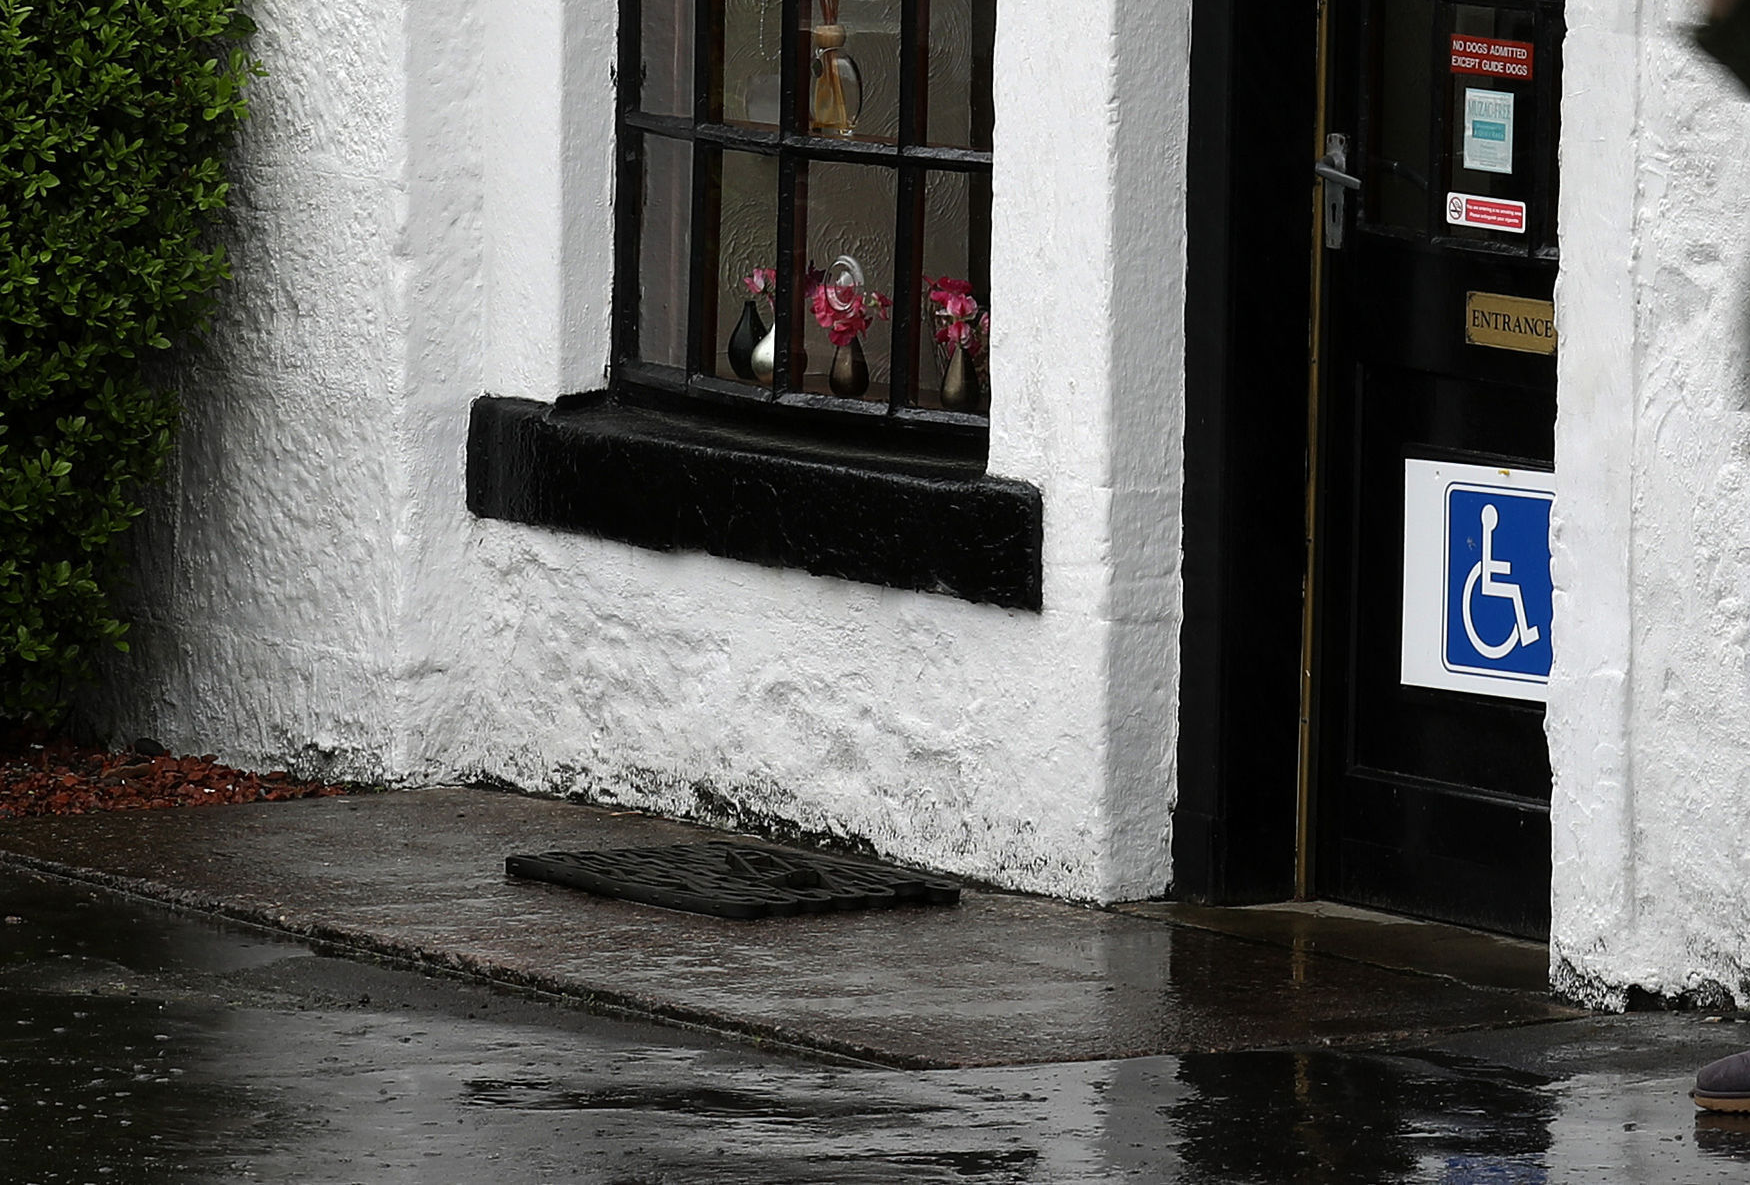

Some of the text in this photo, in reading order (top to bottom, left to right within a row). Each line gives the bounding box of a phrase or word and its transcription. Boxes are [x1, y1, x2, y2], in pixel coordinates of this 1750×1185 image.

[1452, 40, 1528, 59] NO DOGS ADMITTED
[1451, 55, 1528, 76] EXCEPT GUIDE DOGS
[1472, 309, 1554, 338] ENTRANCE
